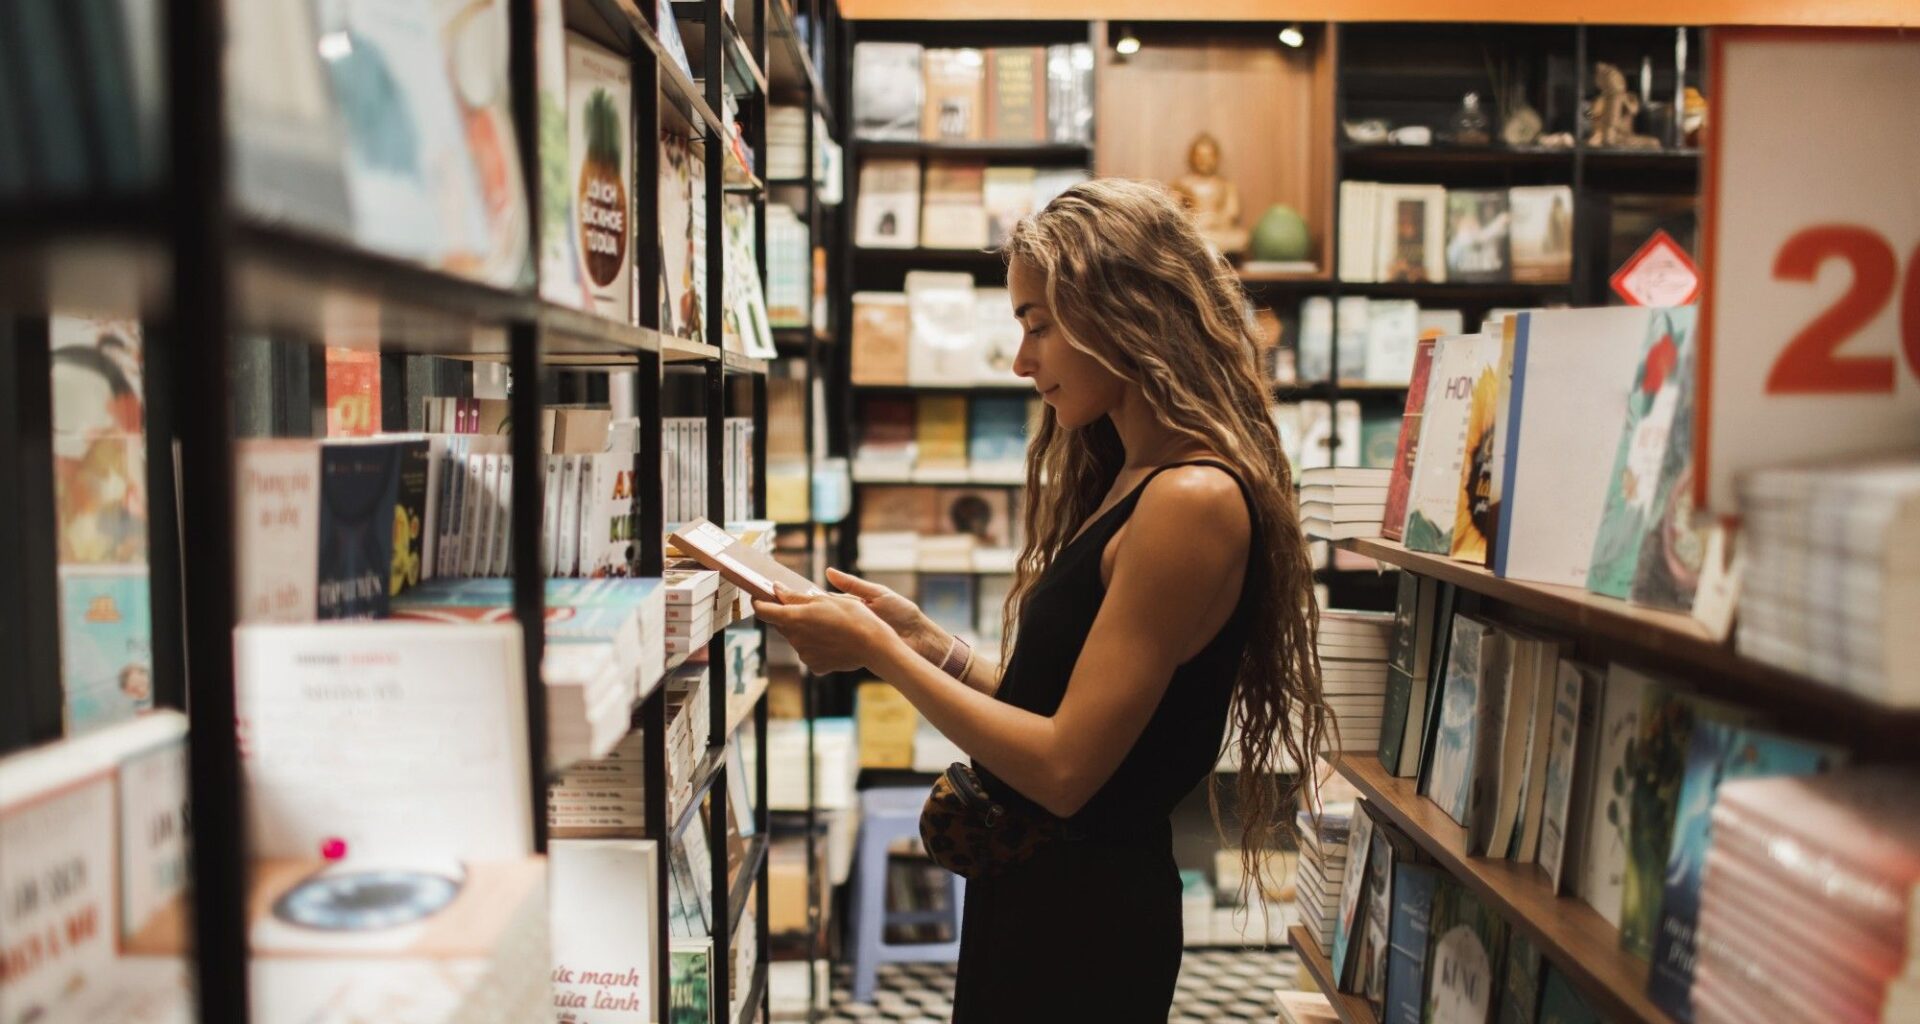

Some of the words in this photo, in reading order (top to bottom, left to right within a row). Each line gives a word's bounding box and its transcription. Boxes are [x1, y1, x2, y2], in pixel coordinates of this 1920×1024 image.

[1763, 223, 1920, 396] 2
[551, 965, 575, 983] ức
[578, 967, 640, 989] mạnh
[553, 990, 587, 1009] ữa
[593, 989, 640, 1011] lành
